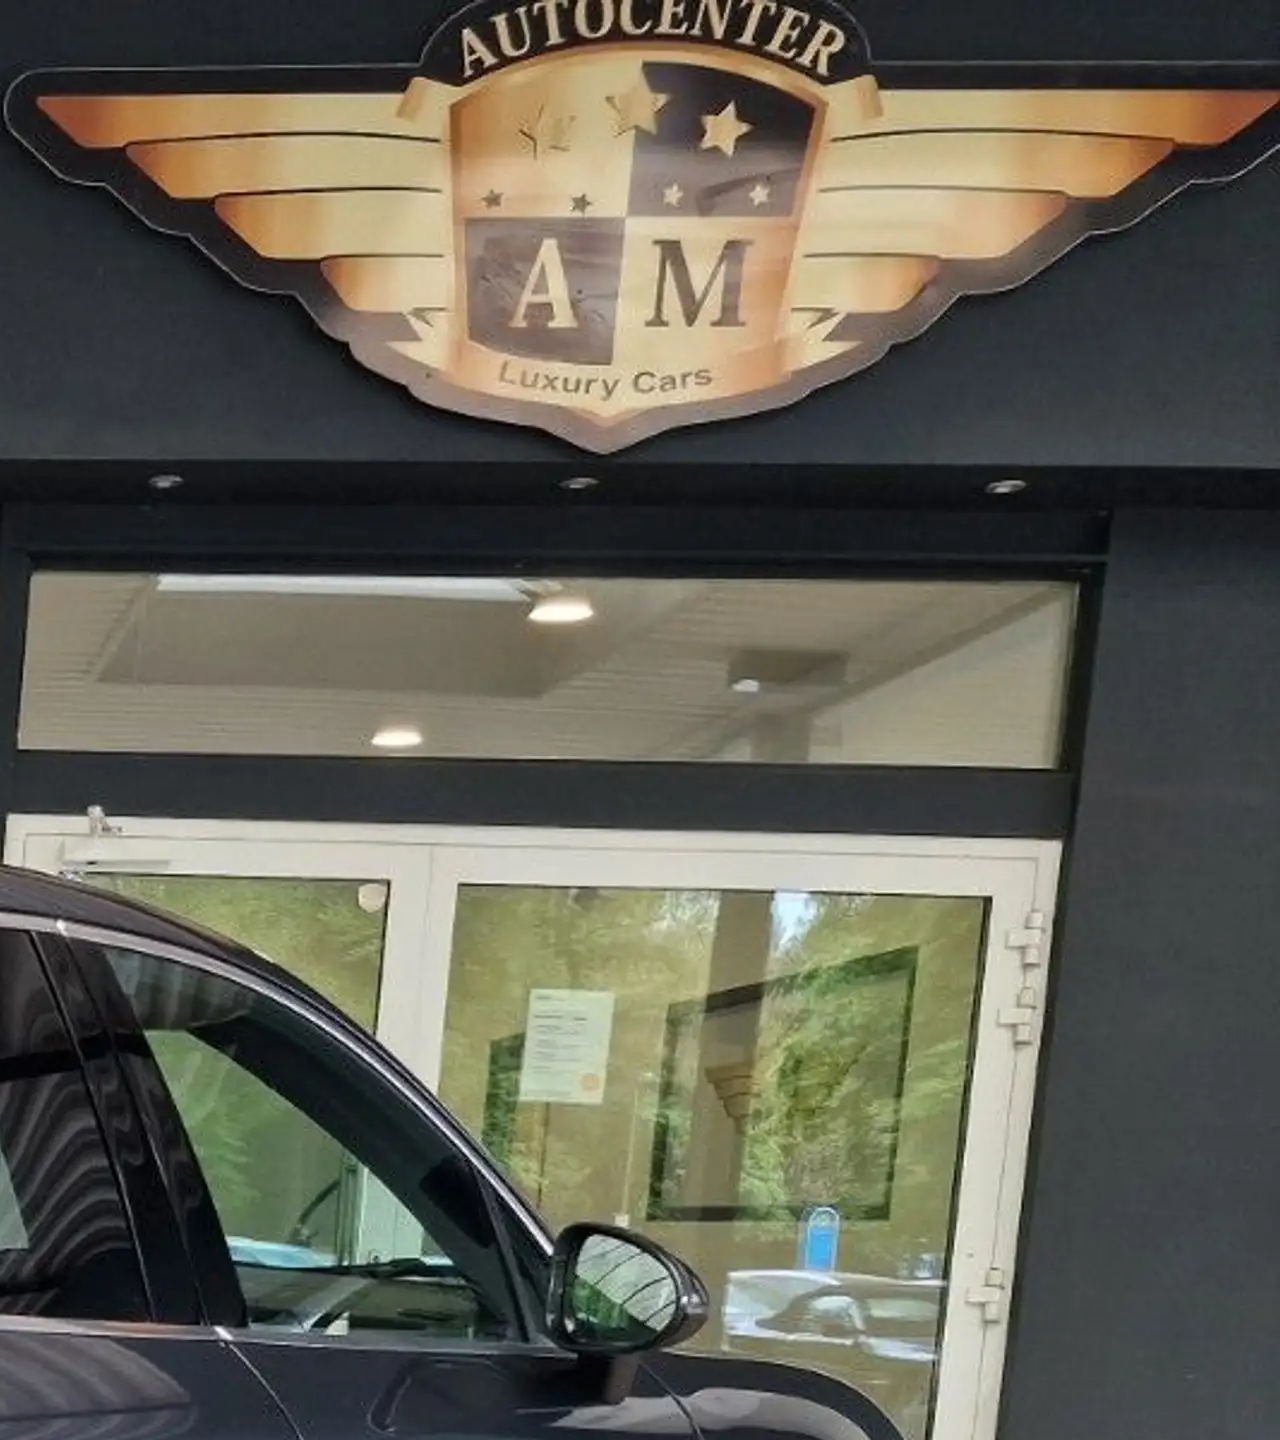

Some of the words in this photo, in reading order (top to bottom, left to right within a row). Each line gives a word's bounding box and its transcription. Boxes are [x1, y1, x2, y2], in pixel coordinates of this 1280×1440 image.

[461, 0, 847, 77] AUTOCENTER
[507, 237, 579, 328] A
[643, 239, 755, 328] M
[498, 360, 620, 401] Luxury
[632, 368, 714, 395] Cars
